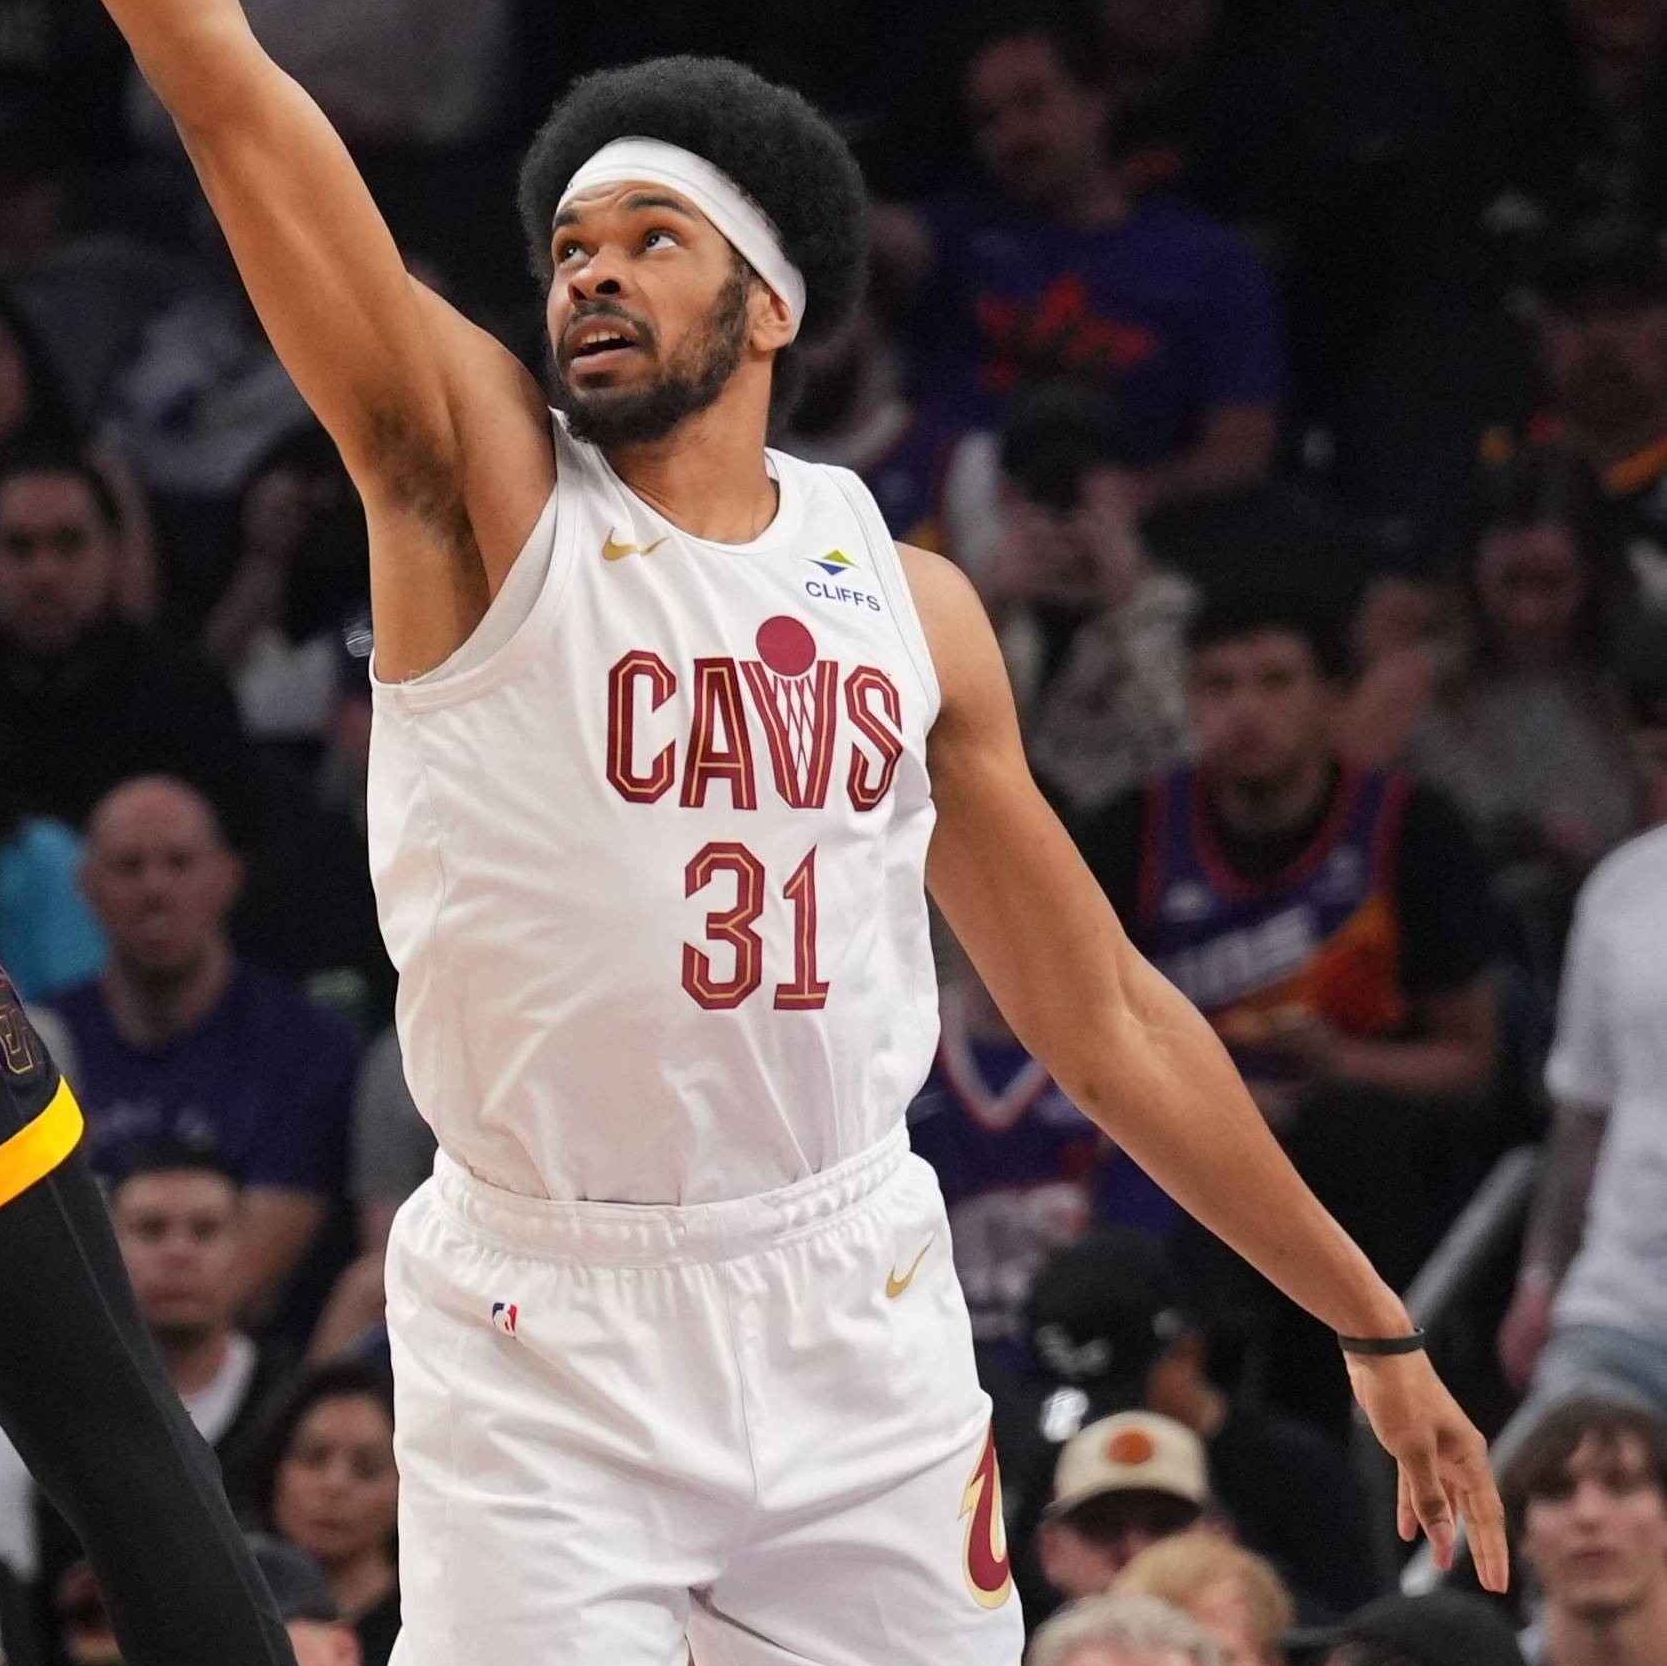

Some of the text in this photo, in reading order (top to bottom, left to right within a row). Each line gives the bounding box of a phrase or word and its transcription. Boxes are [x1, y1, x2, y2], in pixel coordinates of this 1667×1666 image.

[804, 580, 881, 613] CLIFFS
[605, 648, 904, 812] CAVS
[681, 841, 831, 1011] 31
